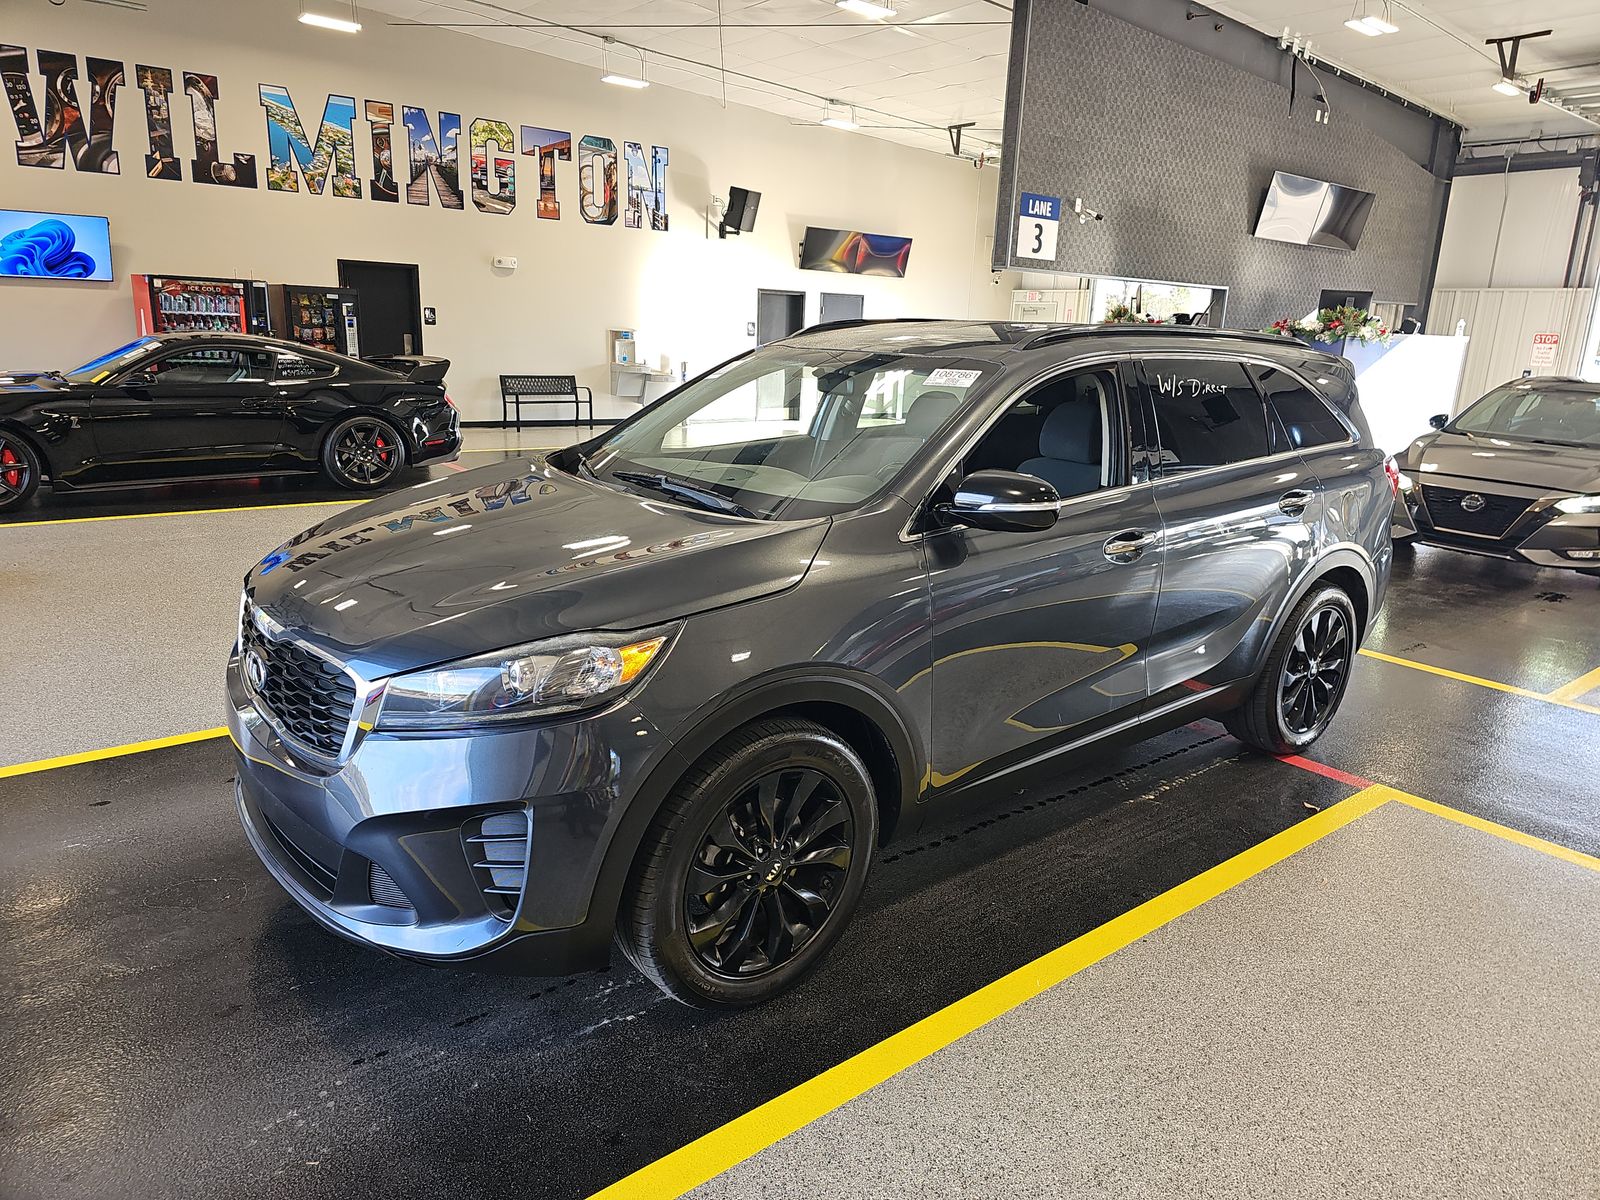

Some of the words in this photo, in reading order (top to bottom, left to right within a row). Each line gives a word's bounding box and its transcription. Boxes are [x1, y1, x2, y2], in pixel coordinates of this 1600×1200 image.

[0, 43, 669, 232] WILMINGTON
[1028, 199, 1052, 217] LANE
[1031, 223, 1043, 254] 3
[201, 285, 221, 293] COLD
[1534, 335, 1558, 343] STOP
[1156, 374, 1184, 398] W/S
[766, 863, 781, 881] KIA
